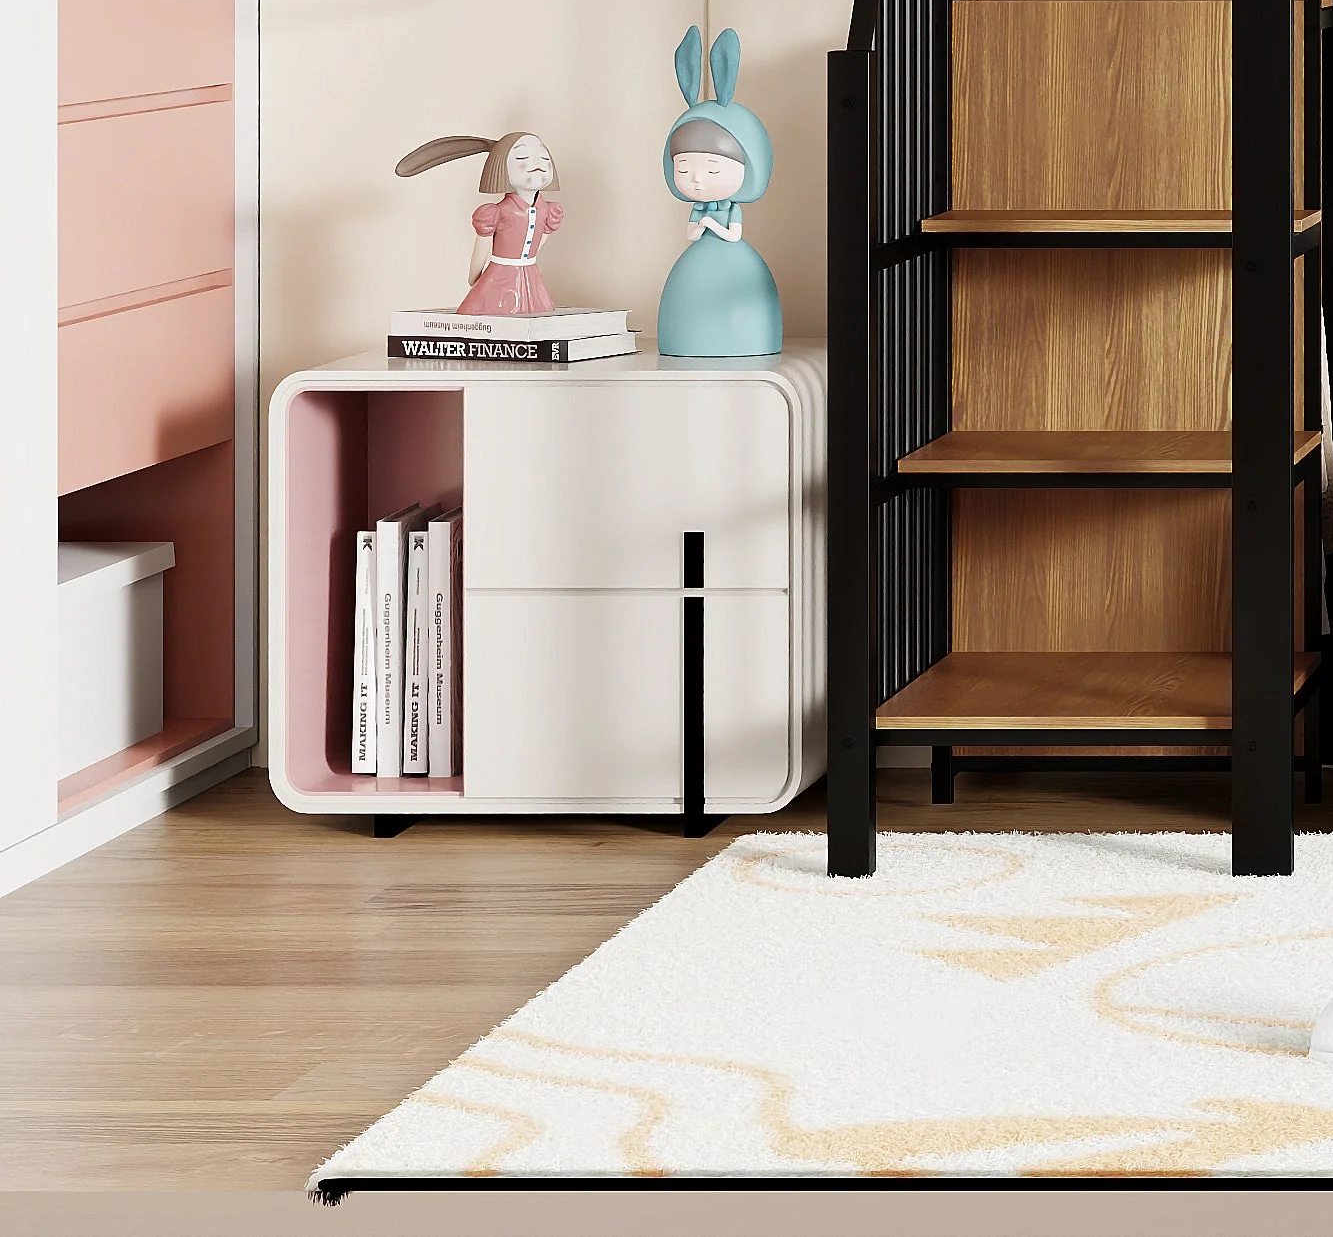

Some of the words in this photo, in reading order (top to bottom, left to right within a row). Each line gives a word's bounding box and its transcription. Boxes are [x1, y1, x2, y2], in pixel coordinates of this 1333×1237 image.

[402, 339, 466, 358] WALTER
[468, 340, 538, 359] FINANCE
[383, 593, 392, 670] Guggenheim
[434, 592, 444, 670] Guggenheim
[360, 682, 368, 698] IT
[384, 673, 392, 726] Museum
[411, 682, 420, 698] IT
[436, 672, 444, 725] Museum
[358, 701, 368, 762] MAKING
[410, 700, 420, 762] MAKING
